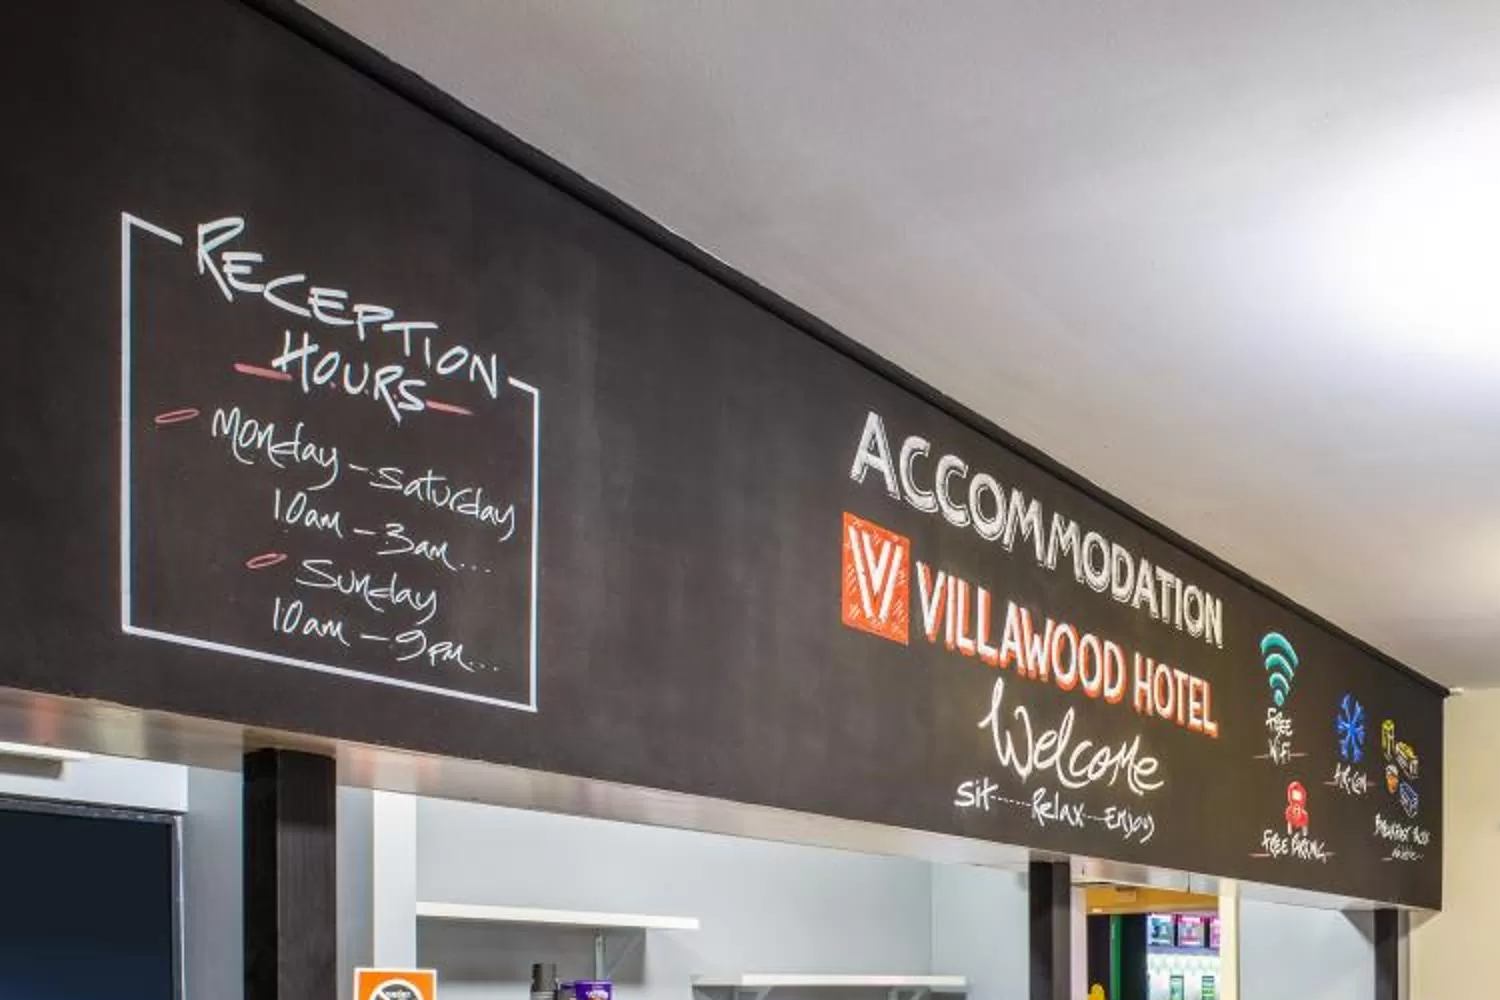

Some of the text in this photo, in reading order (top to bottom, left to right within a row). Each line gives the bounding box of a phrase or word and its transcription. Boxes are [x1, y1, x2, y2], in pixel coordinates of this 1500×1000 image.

[197, 216, 498, 399] RECEPTION
[271, 330, 427, 422] HOURS
[295, 559, 438, 625] Sunday
[850, 411, 1224, 648] ACCOMMODATION
[917, 561, 1218, 738] VILLAWOOD HOTEL
